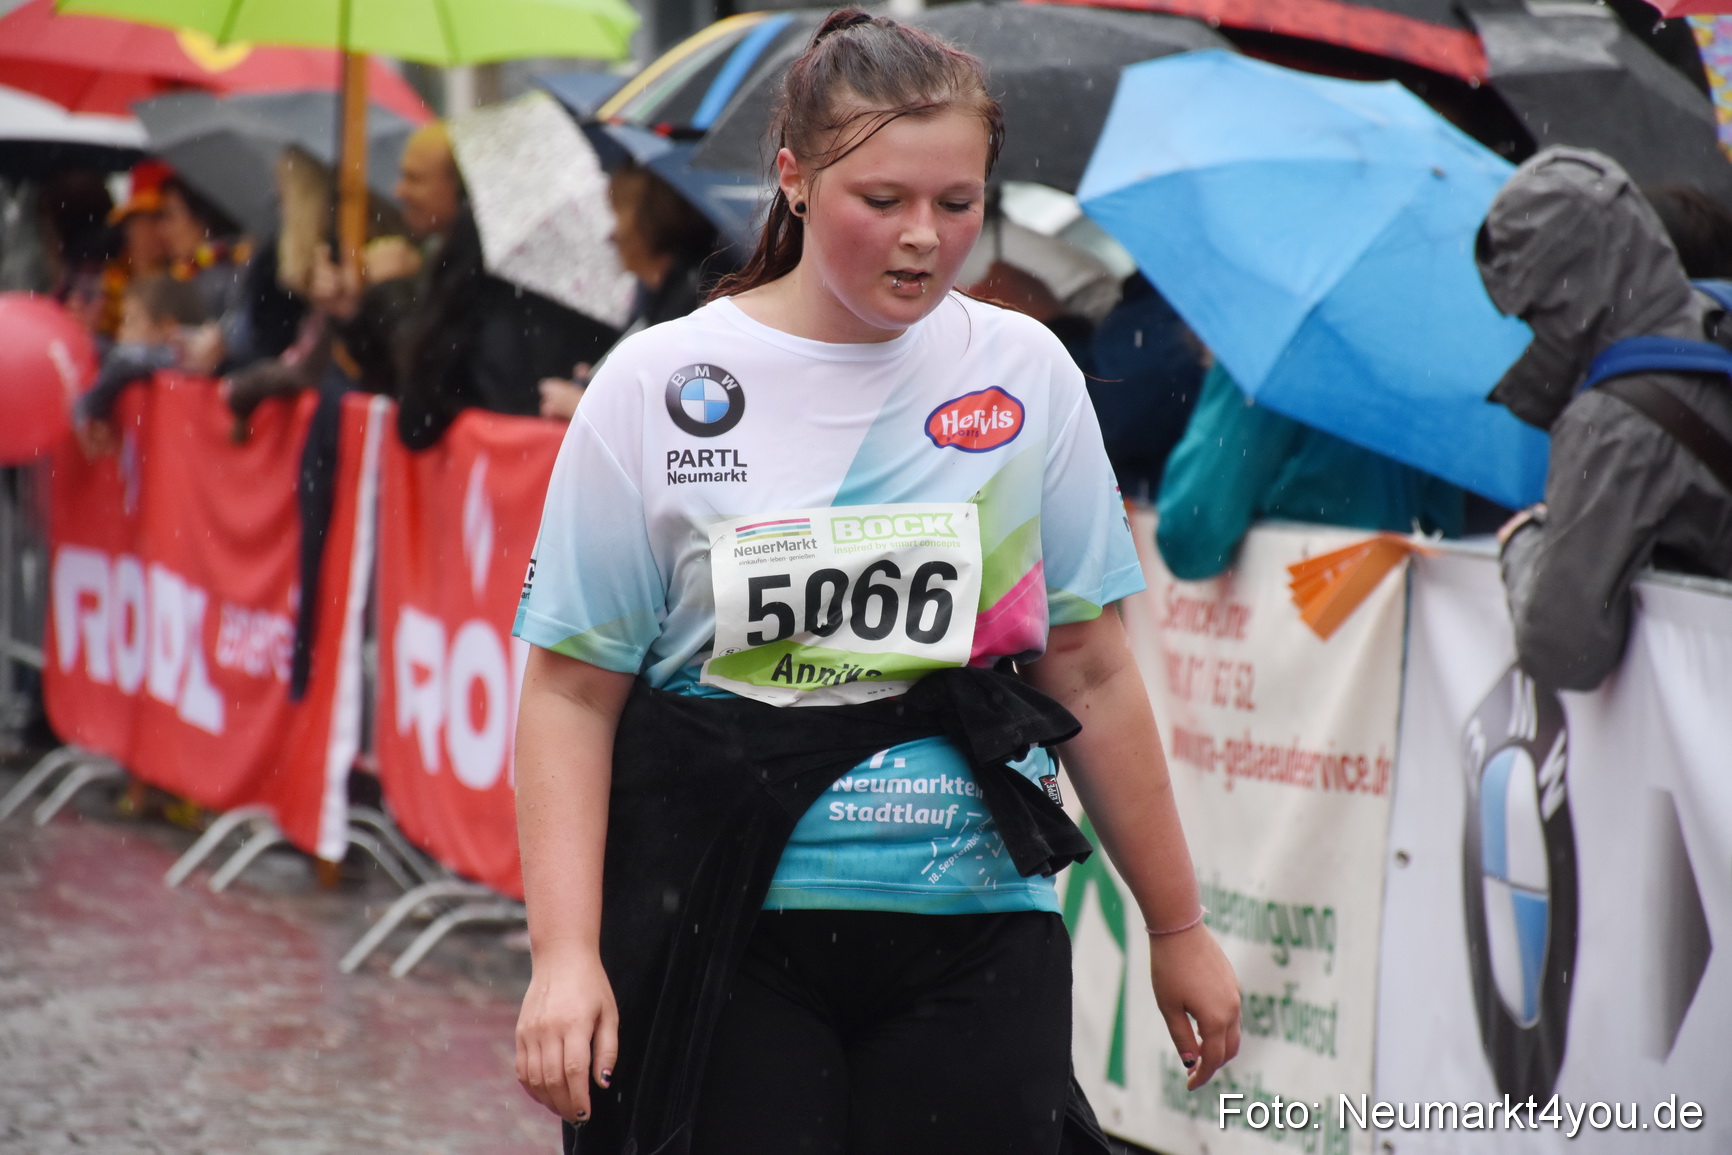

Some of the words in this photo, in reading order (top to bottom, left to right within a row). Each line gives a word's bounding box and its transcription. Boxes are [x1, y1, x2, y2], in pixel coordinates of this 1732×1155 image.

[671, 365, 738, 390] BMW
[941, 405, 1014, 435] Hervis
[667, 449, 747, 470] PARTL
[667, 469, 747, 485] Neumarkt
[831, 513, 958, 544] BOCK
[734, 538, 818, 558] NeuerMarkt
[834, 544, 872, 555] inspired
[875, 541, 887, 551] by
[890, 540, 917, 548] smart
[920, 539, 961, 549] concepts
[747, 560, 958, 646] 5066
[394, 605, 522, 789] RO
[829, 801, 960, 830] Stadtlauf
[928, 872, 942, 885] 18.
